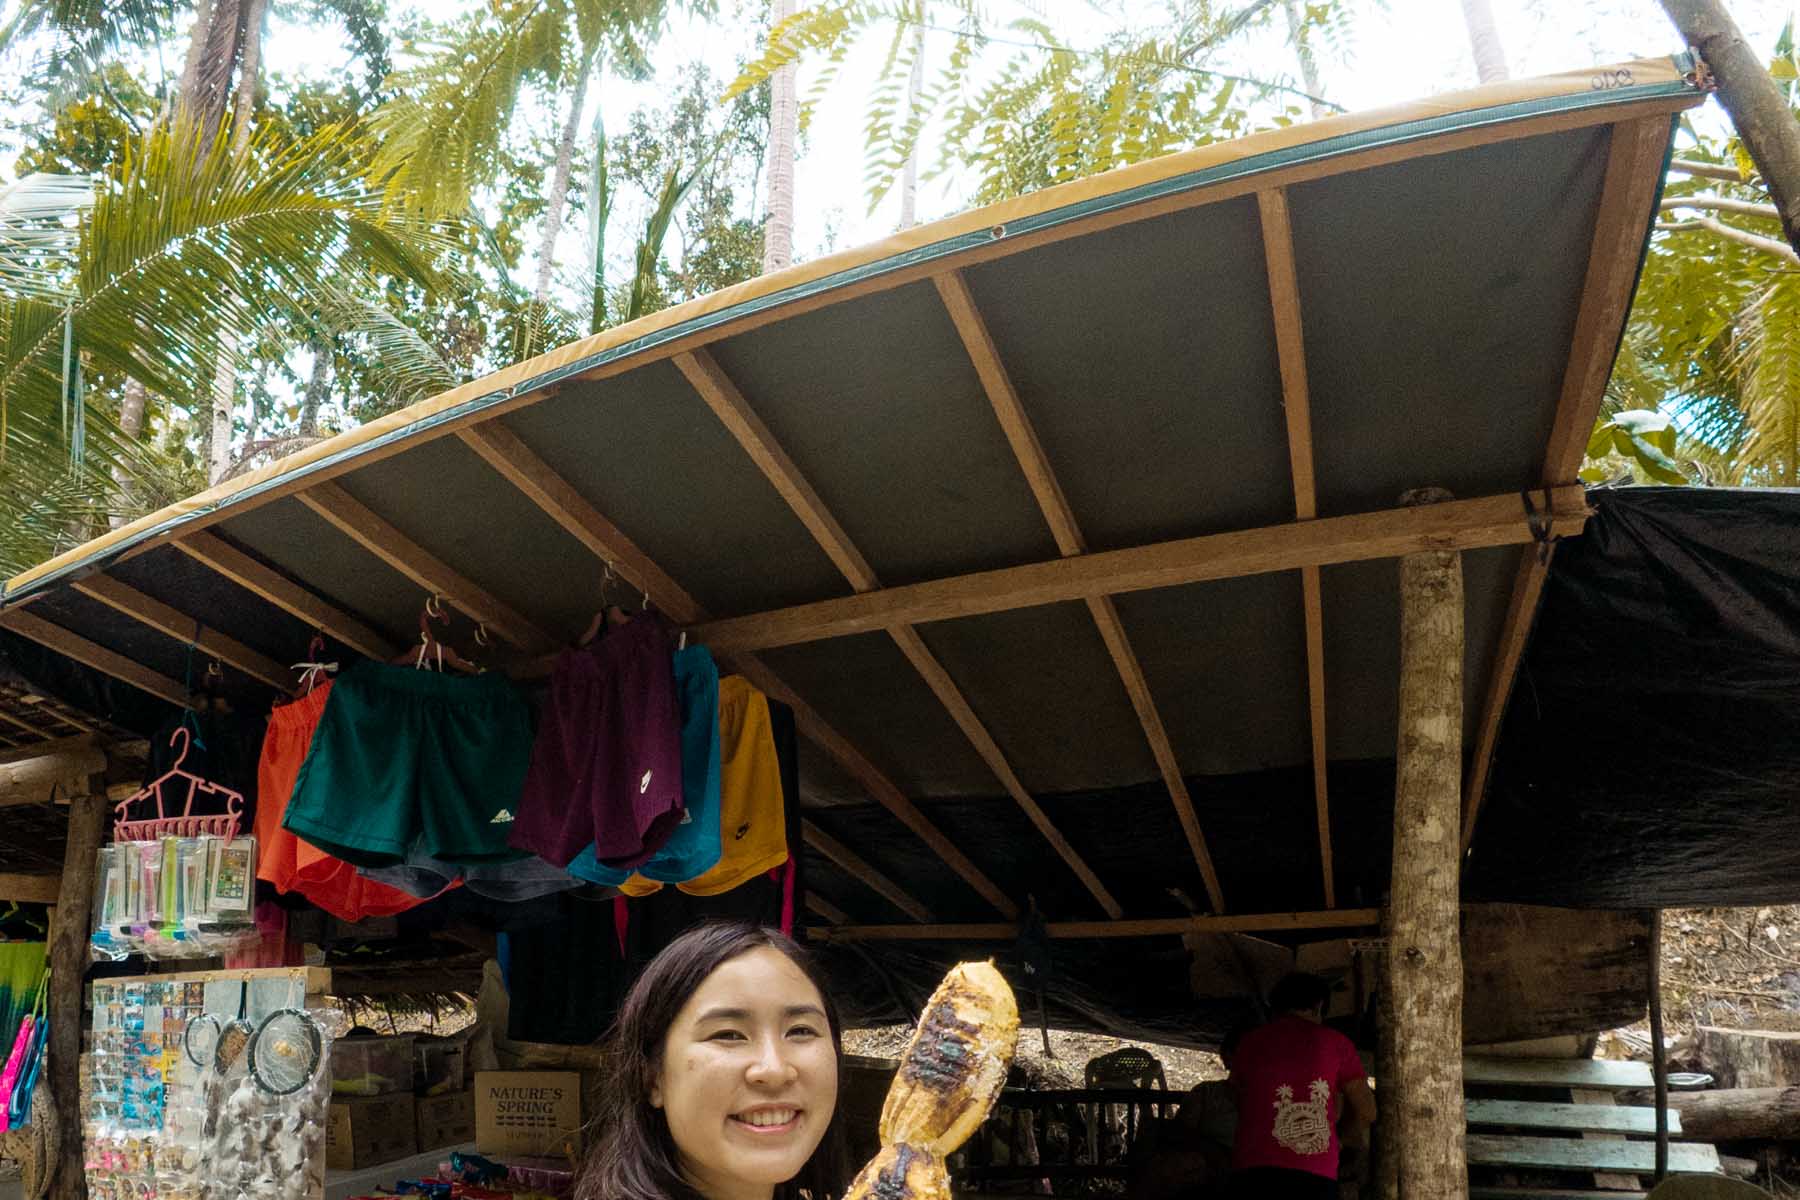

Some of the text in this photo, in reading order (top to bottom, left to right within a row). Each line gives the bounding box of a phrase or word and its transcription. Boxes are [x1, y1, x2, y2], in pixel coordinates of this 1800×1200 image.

[489, 1087, 563, 1100] NATURE'S
[497, 1101, 554, 1113] SPRING
[1279, 1119, 1328, 1138] CEBU
